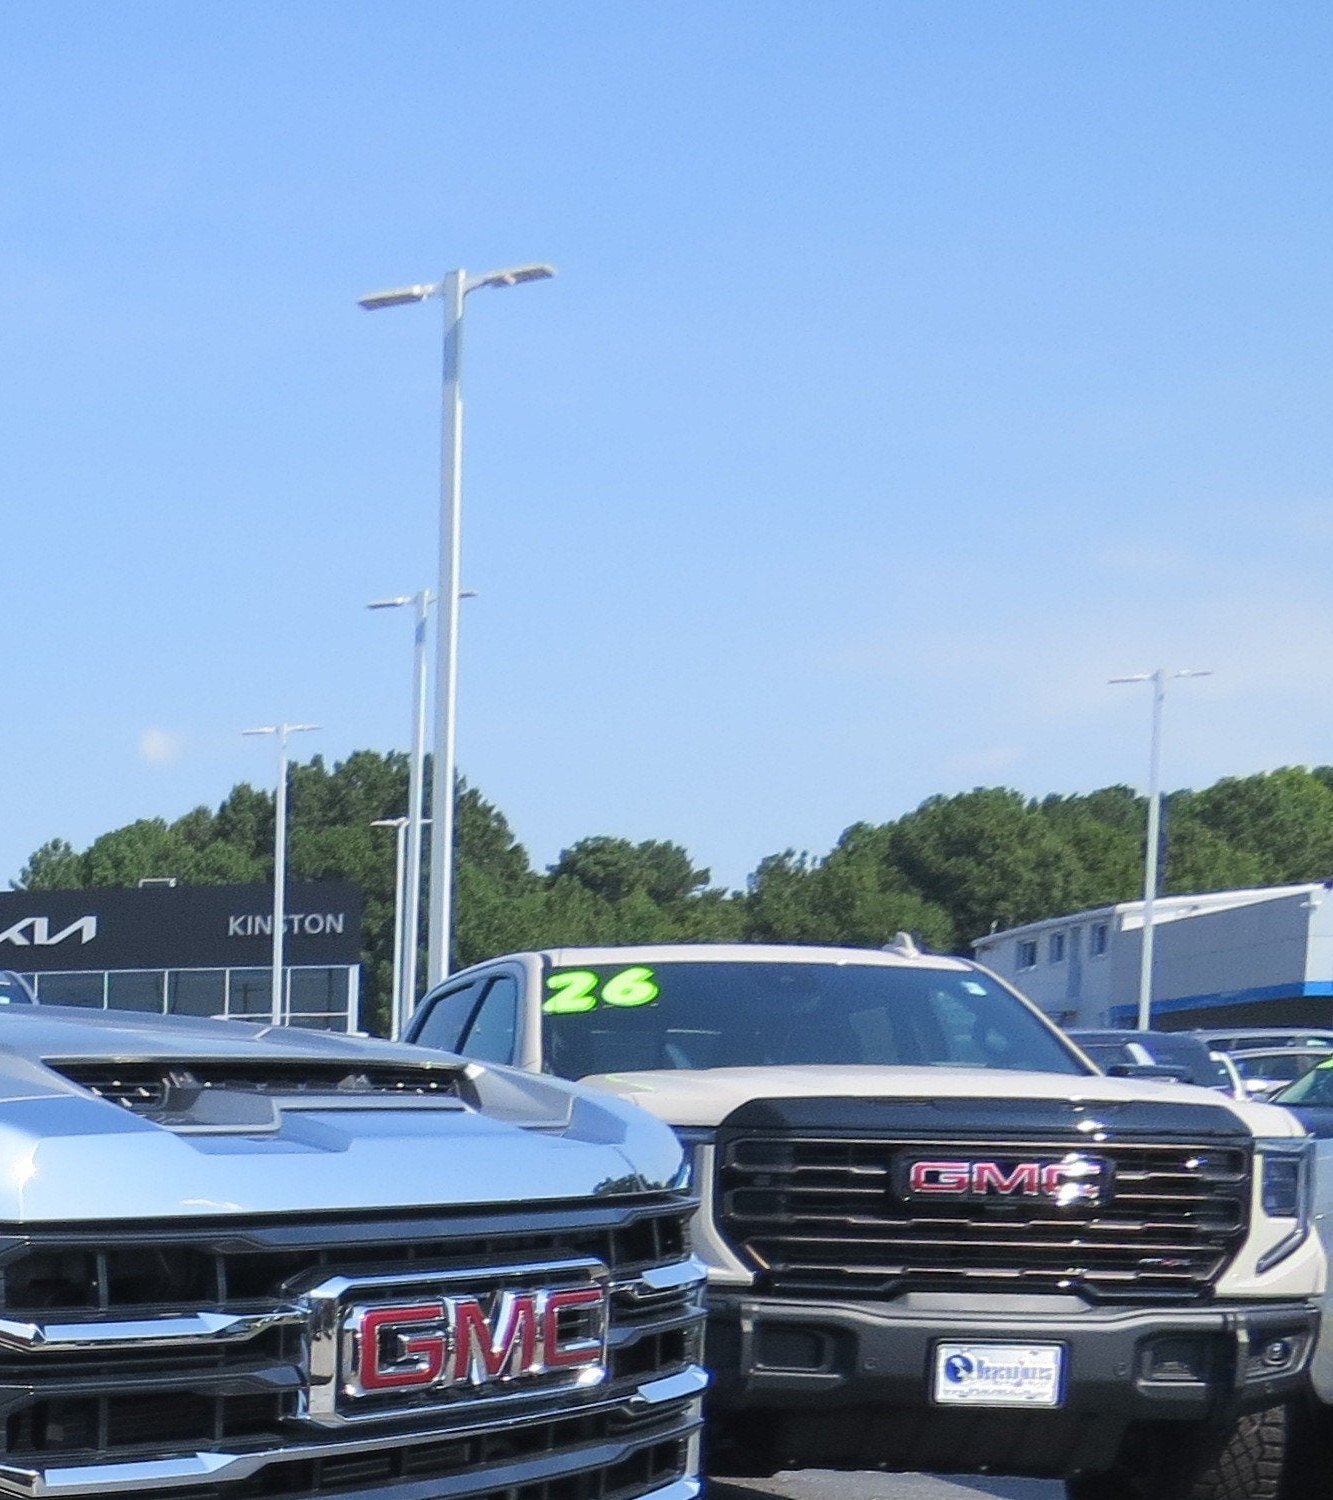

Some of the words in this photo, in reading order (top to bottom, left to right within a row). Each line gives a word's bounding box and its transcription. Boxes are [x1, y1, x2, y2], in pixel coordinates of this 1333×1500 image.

[542, 966, 659, 1013] 26
[910, 1162, 1101, 1197] GMC
[353, 1284, 606, 1394] GMC
